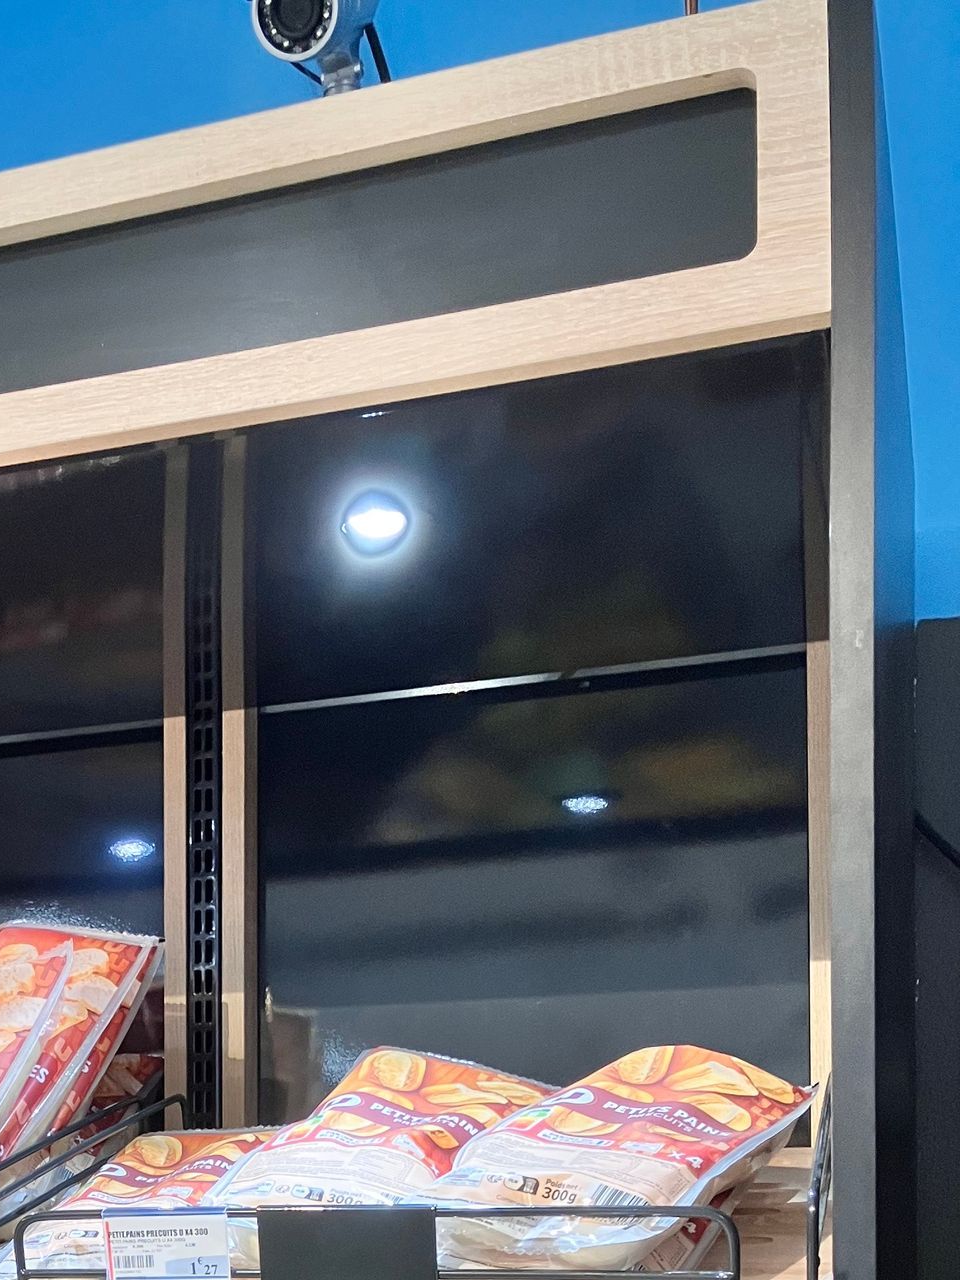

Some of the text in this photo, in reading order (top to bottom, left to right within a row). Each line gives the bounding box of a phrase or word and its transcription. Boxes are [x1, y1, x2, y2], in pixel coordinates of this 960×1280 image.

[541, 1187, 568, 1201] 300
[146, 1228, 178, 1237] PRECUITS
[195, 1227, 208, 1236] 300
